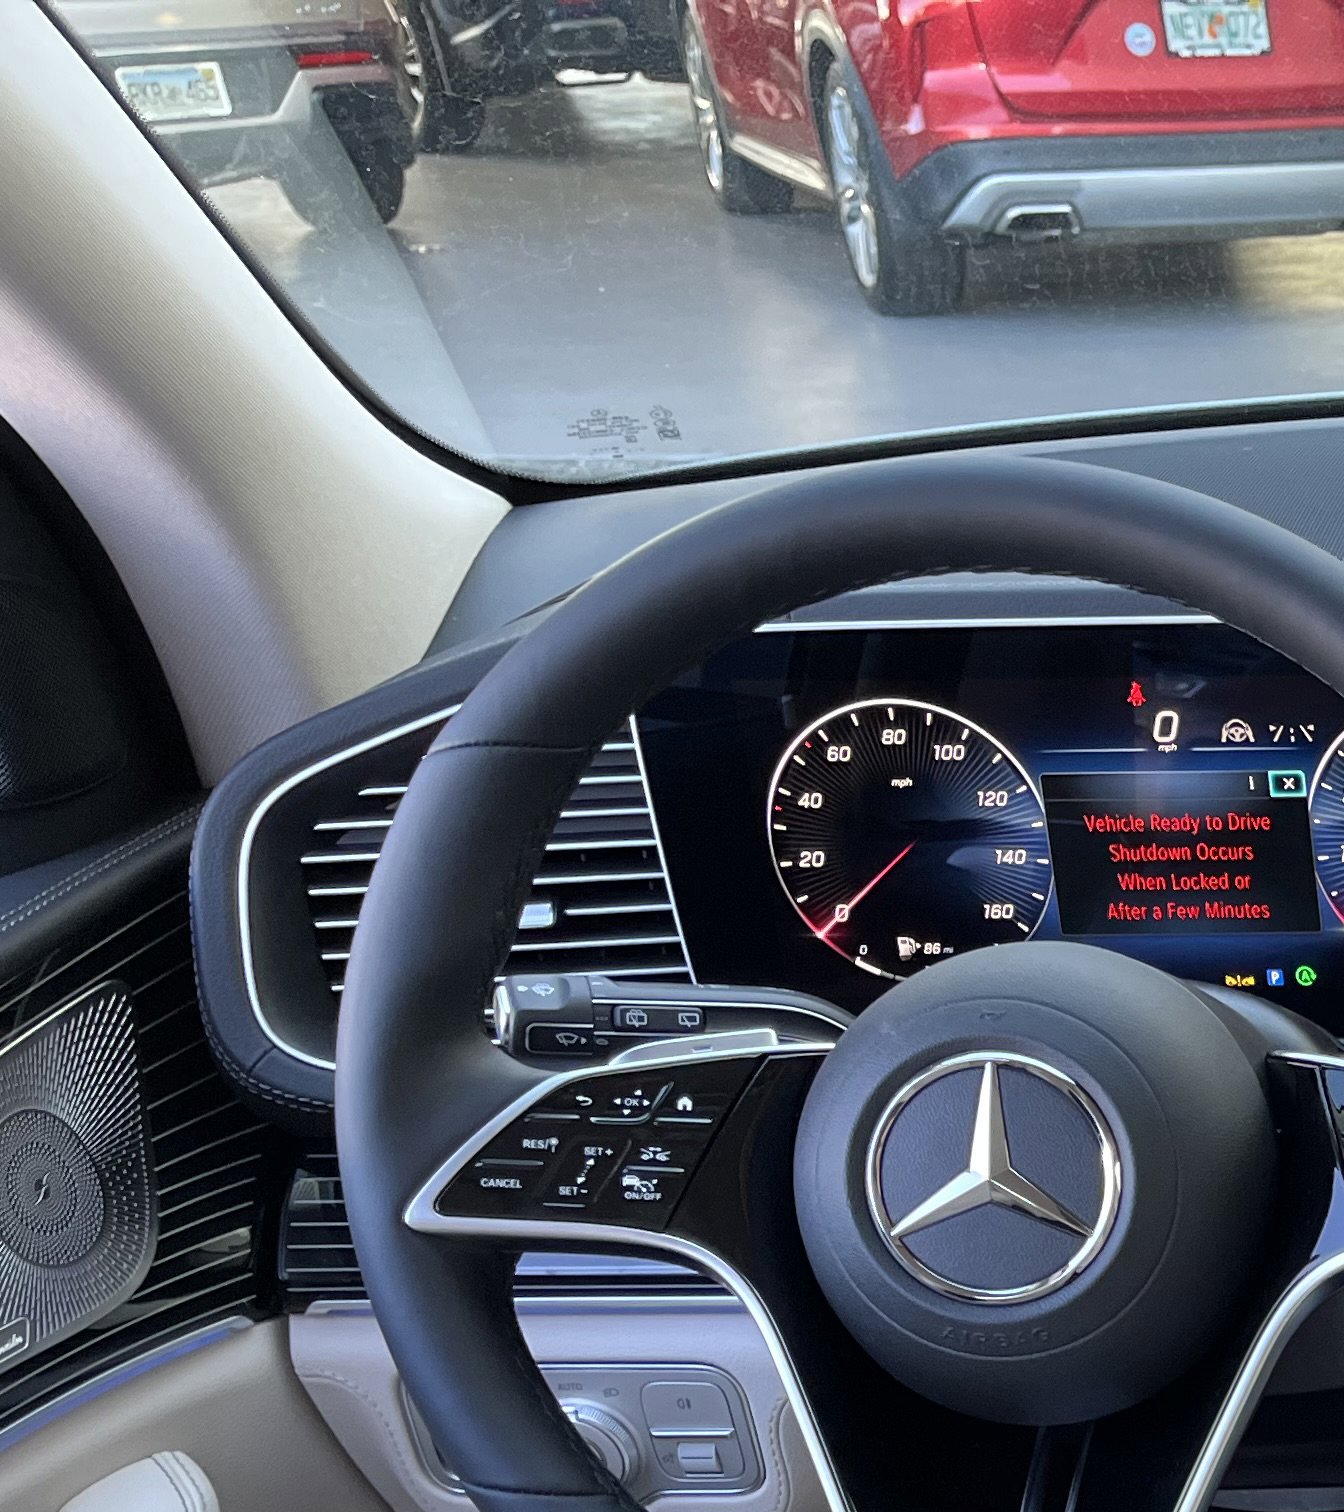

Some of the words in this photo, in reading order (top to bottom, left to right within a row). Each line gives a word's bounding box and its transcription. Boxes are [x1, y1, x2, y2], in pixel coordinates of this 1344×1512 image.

[1152, 710, 1179, 743] 0
[881, 729, 907, 745] 80
[826, 745, 852, 762] 60
[933, 744, 966, 761] 100
[1158, 743, 1178, 754] mph
[890, 777, 913, 789] mph
[797, 792, 823, 809] 40
[976, 790, 1008, 807] 120
[1083, 813, 1145, 833] Vehicle
[1149, 813, 1200, 836] Ready
[1205, 815, 1223, 831] to
[1227, 812, 1272, 831] Drive
[799, 850, 825, 868] 20
[994, 848, 1028, 865] 140
[1108, 843, 1192, 863] Shutdown
[1196, 842, 1255, 861] Occurs
[1117, 872, 1167, 891] When
[1171, 872, 1230, 891] Locked
[1234, 874, 1252, 890] or
[834, 904, 850, 923] 0
[983, 903, 1015, 920] 160
[1107, 901, 1148, 921] After
[1152, 907, 1163, 921] a
[1166, 901, 1200, 920] Few
[1204, 900, 1272, 920] Minutes
[858, 944, 868, 955] 0
[922, 943, 941, 955] 86
[624, 1097, 640, 1107] OK
[584, 1146, 604, 1156] SET
[480, 1177, 523, 1189] CANCEL
[558, 1185, 578, 1196] SET
[624, 1191, 662, 1201] ON/OFF
[557, 1383, 583, 1392] AUTO
